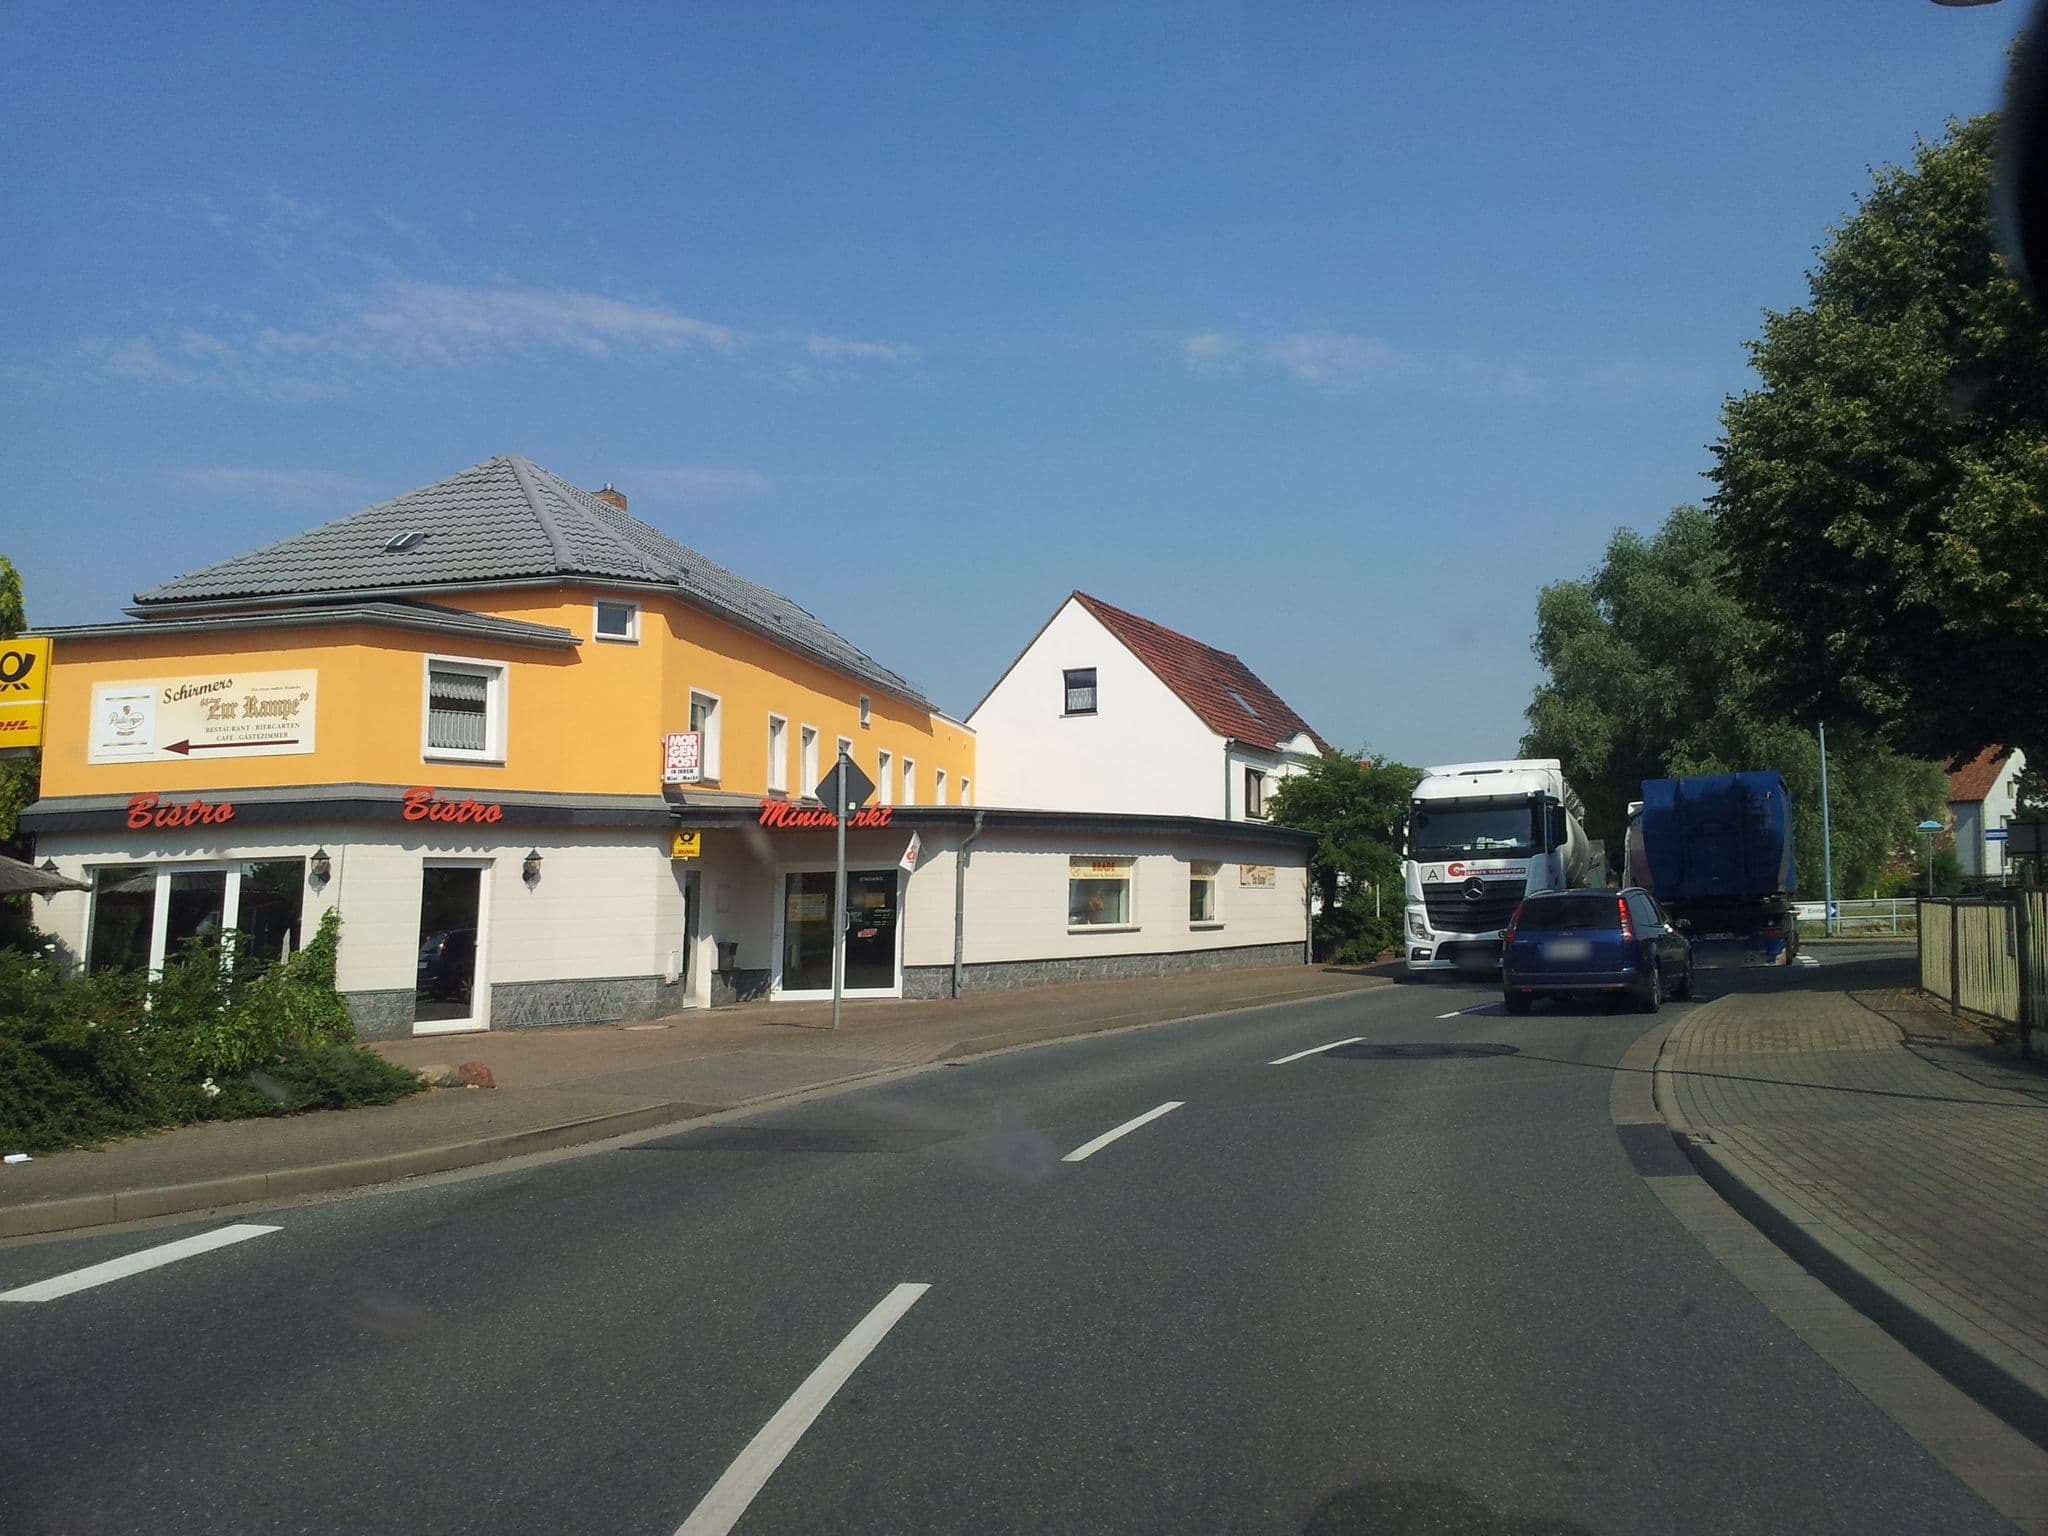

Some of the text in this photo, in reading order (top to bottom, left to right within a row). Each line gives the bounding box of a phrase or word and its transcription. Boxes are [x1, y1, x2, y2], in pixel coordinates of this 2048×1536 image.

[163, 678, 233, 704] Schirmers
[206, 722, 300, 733] RESTAURANT BIERGARTEN
[669, 735, 697, 746] MOR
[669, 745, 697, 757] GEN
[668, 756, 697, 768] POST
[127, 792, 235, 829] Bistro
[402, 785, 503, 824] Bistro
[758, 798, 893, 828] Minimrkt
[1427, 869, 1439, 881] A
